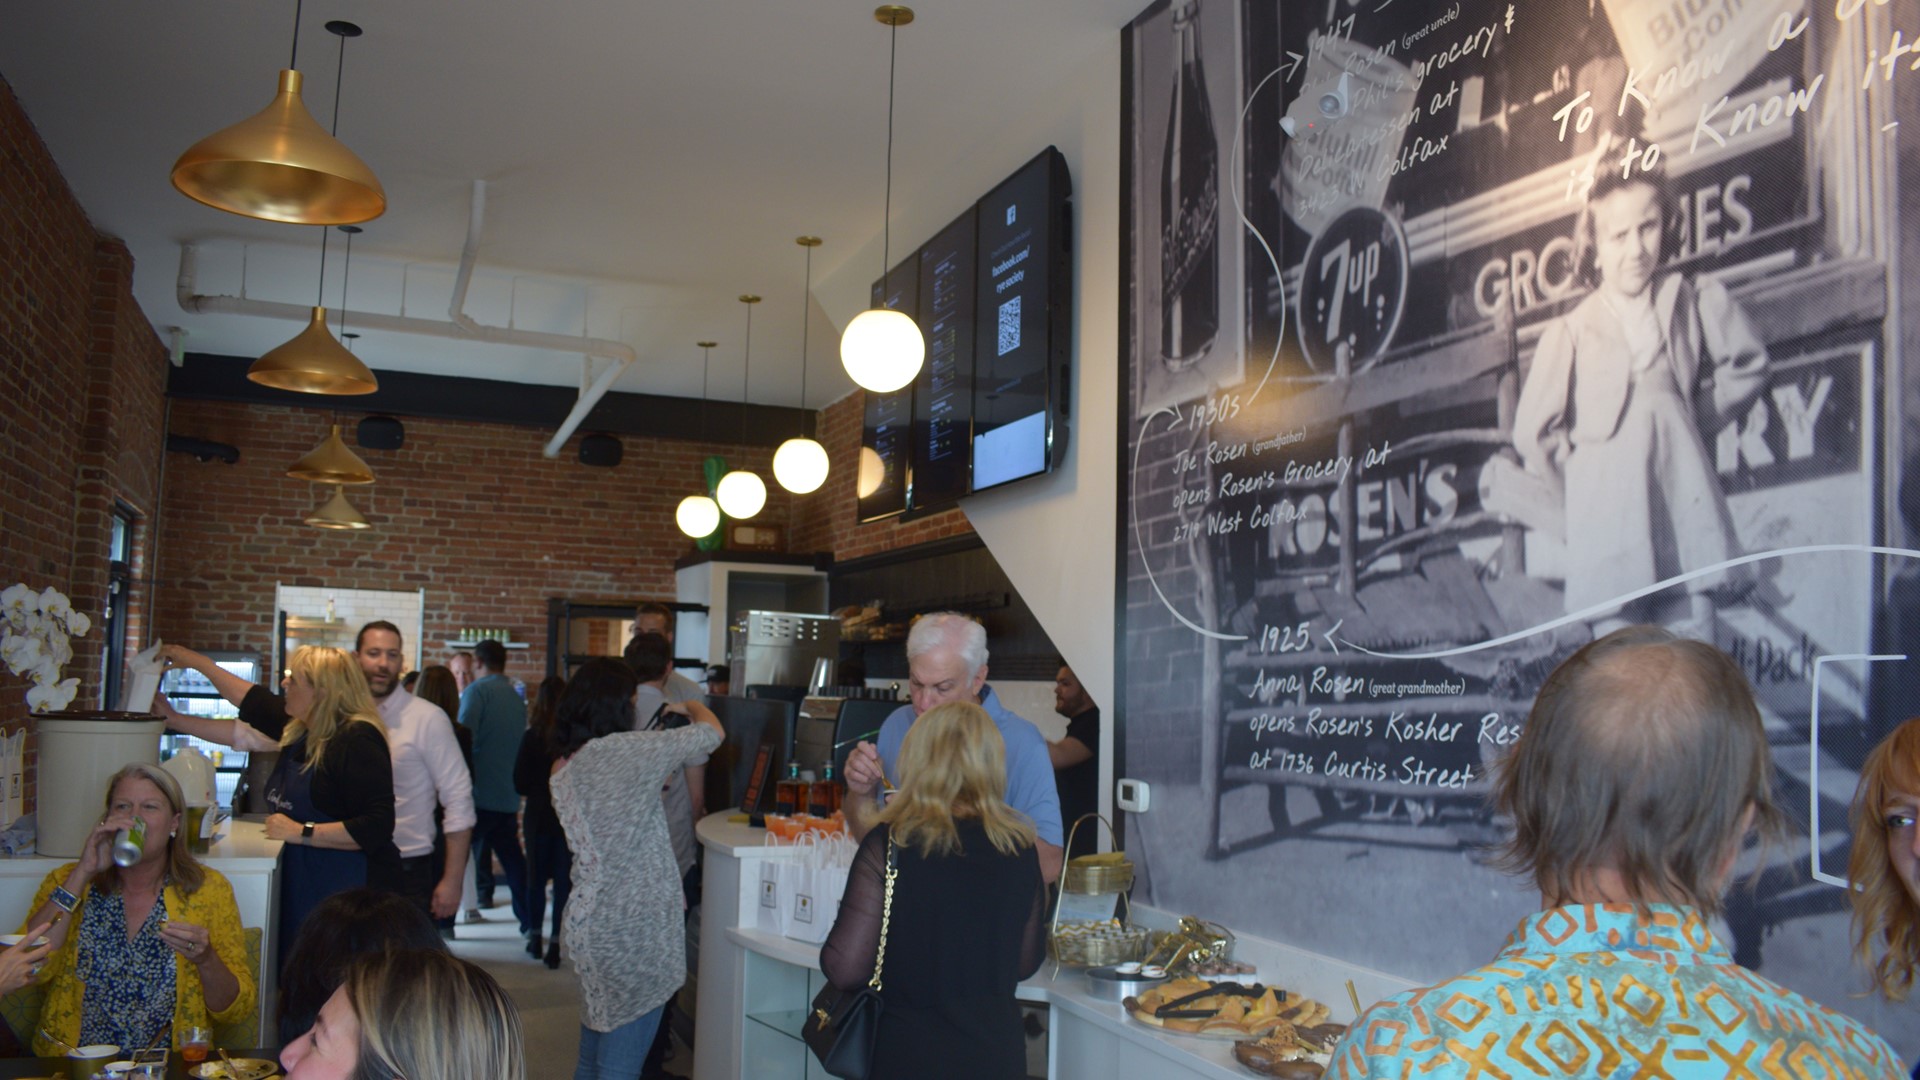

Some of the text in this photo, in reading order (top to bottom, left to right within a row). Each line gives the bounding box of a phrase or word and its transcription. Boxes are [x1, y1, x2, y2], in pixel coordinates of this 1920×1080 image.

[1307, 13, 1356, 68] 1947
[1402, 25, 1429, 49] (great
[1430, 3, 1460, 33] uncle)
[1411, 23, 1498, 92] grocery
[1553, 11, 1810, 141] To Know a
[1299, 108, 1421, 183] Delicatessen
[1430, 81, 1460, 116] at
[1620, 137, 1660, 180] to
[1690, 74, 1824, 154] Know
[1376, 134, 1448, 182] Colfax
[1189, 394, 1241, 431] 1930s
[1173, 425, 1307, 475] Joe Rosen (grandfather)
[1173, 440, 1392, 516] opens Rosen's Grocery at
[1207, 513, 1243, 536] West
[1250, 498, 1308, 530] Colfax
[1260, 621, 1310, 653] 1925
[1249, 665, 1466, 699] Anna Rosen (great grandmother)
[1249, 707, 1524, 745] opens Rosen's Kosher Res
[1249, 748, 1475, 789] at 1736 Curtis Street
